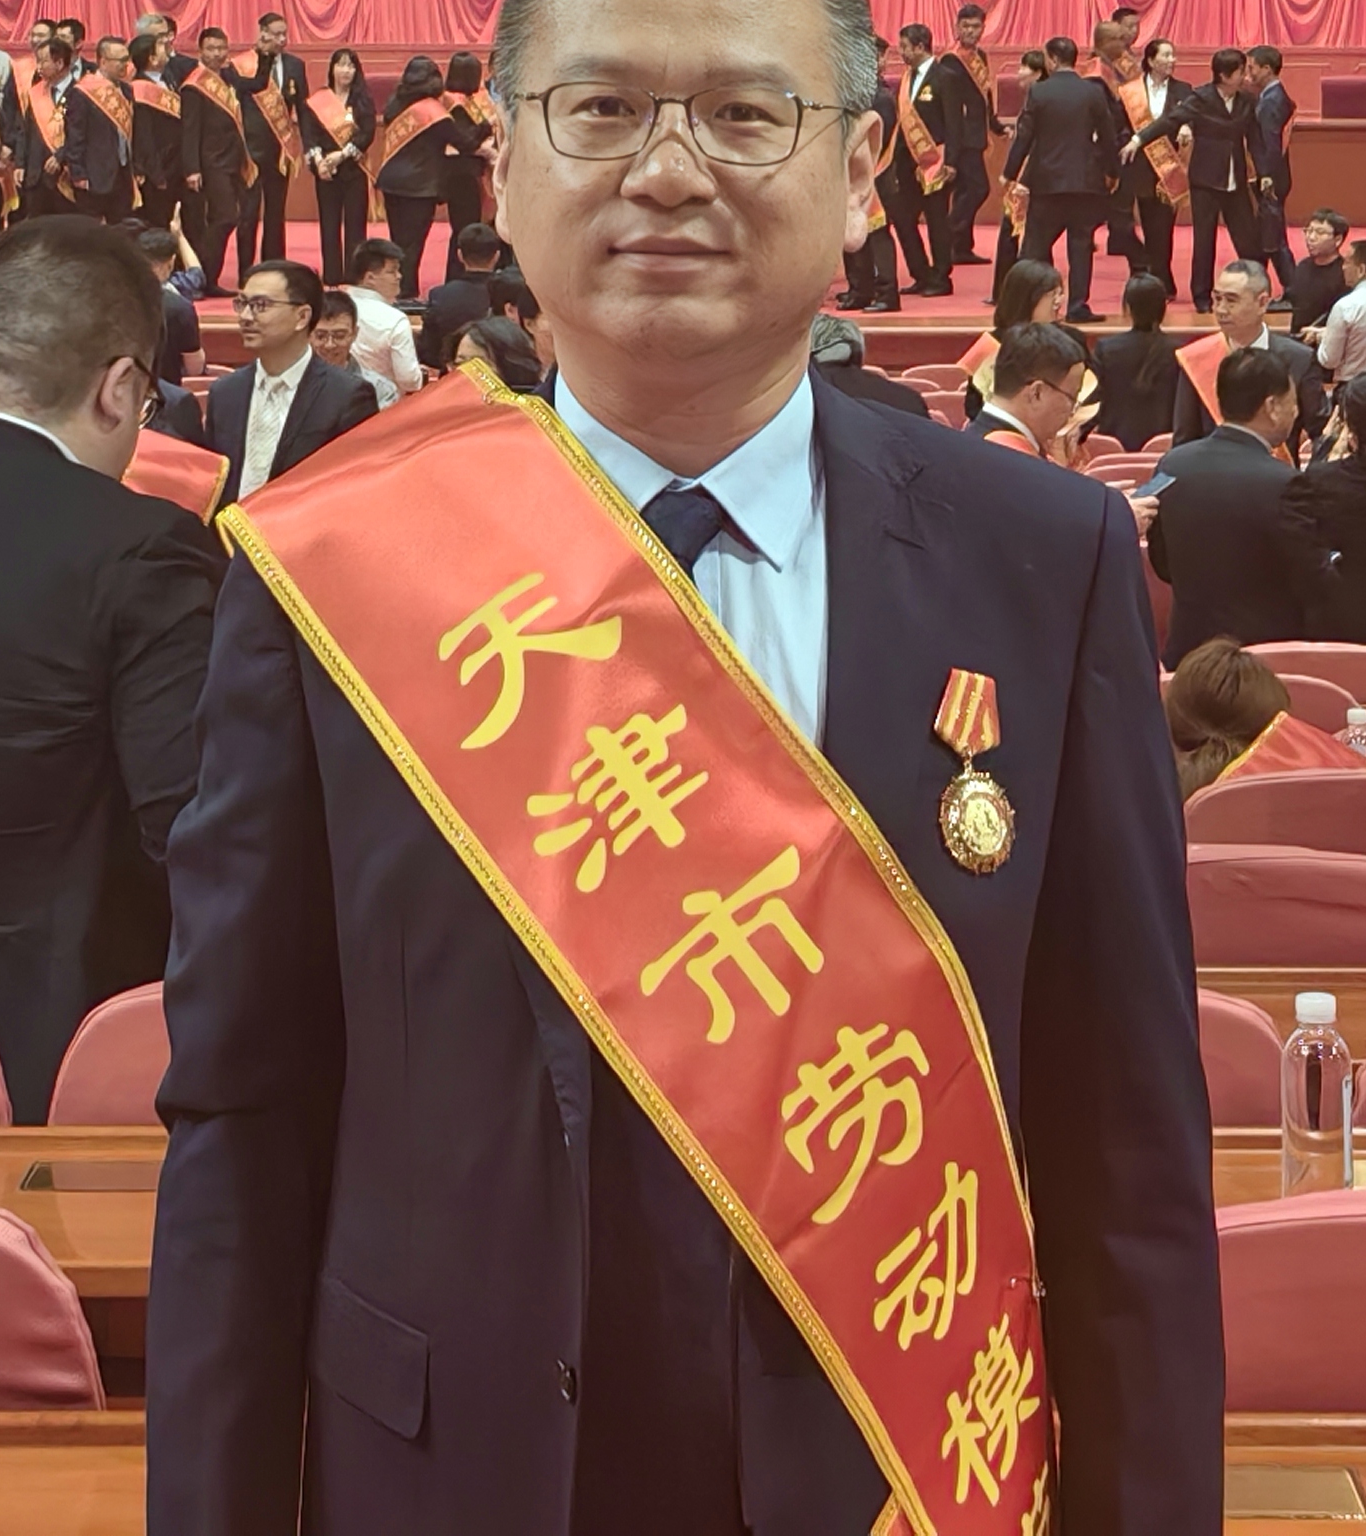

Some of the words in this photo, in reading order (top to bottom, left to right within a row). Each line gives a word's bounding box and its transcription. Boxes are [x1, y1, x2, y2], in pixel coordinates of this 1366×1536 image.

[438, 571, 1050, 1536] 天津市劳动模
